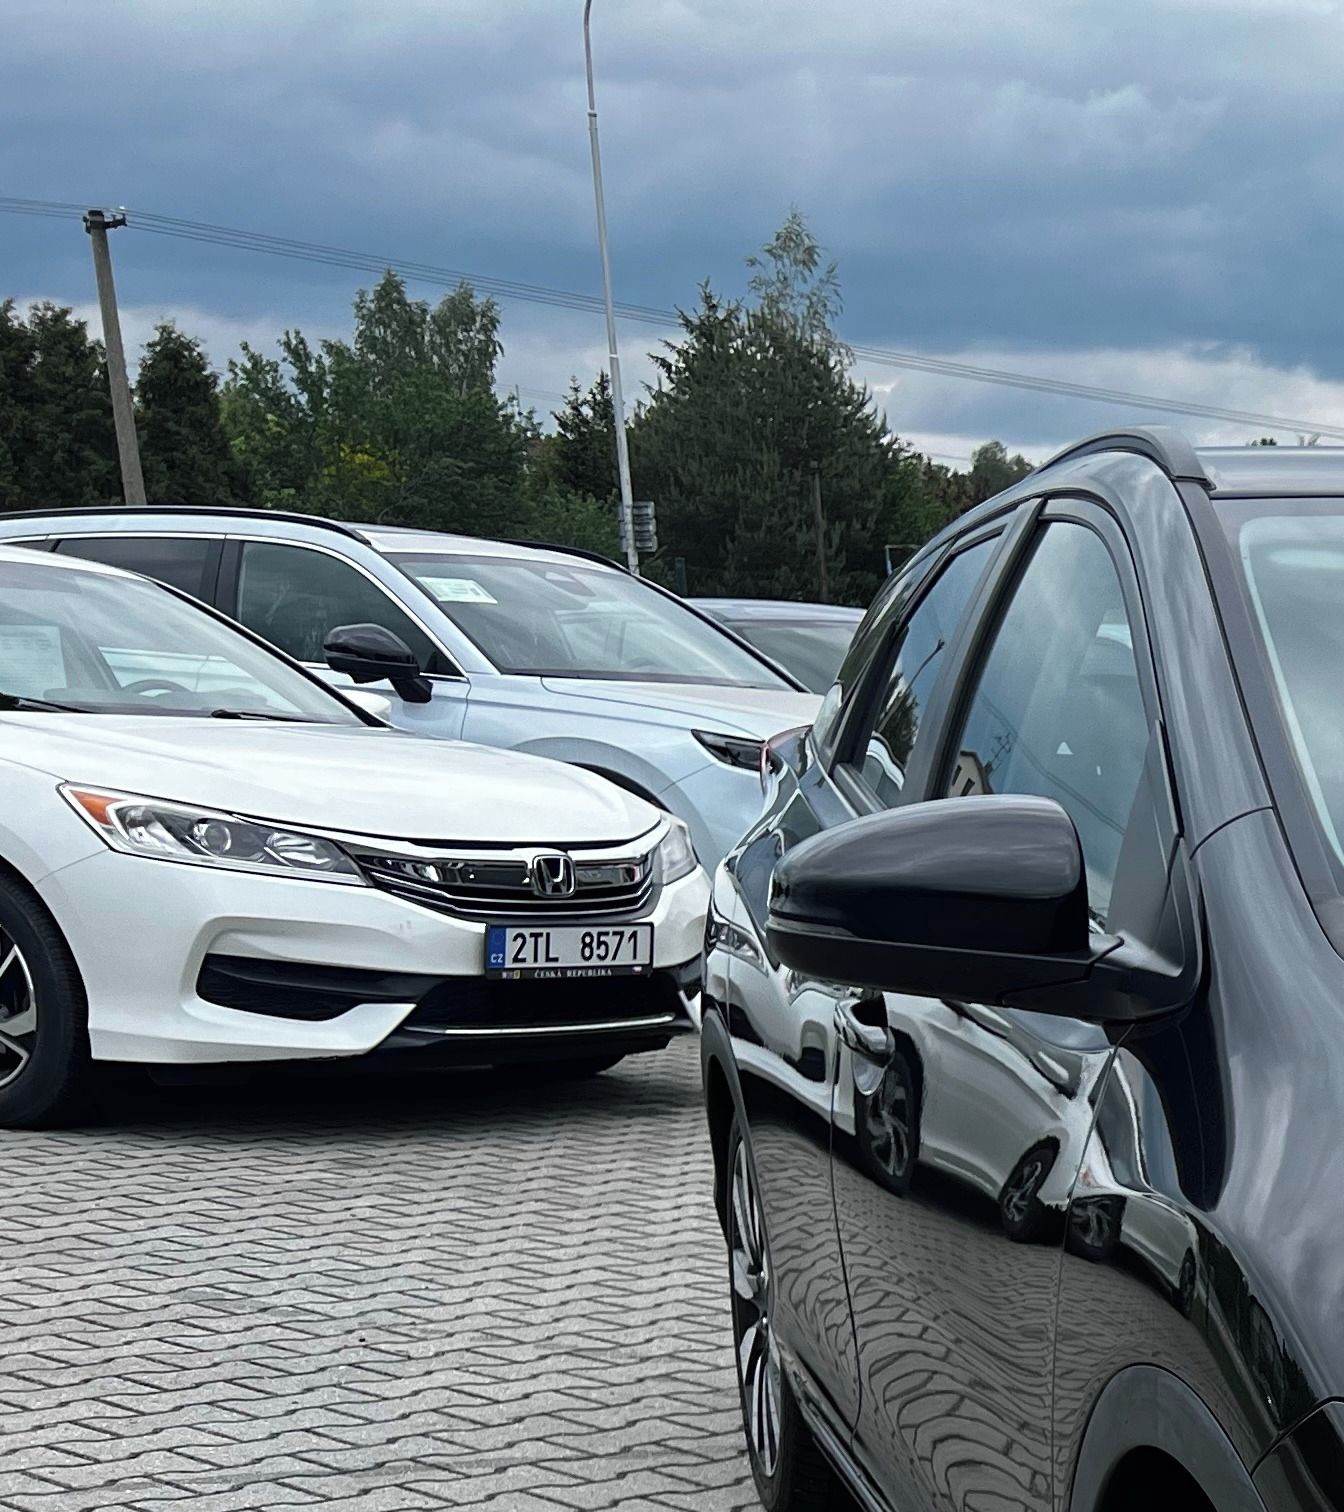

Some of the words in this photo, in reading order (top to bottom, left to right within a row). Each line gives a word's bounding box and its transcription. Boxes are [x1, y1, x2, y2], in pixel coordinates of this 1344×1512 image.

[490, 953, 503, 963] CZ
[512, 931, 559, 964] 2TL
[581, 930, 638, 962] 8571
